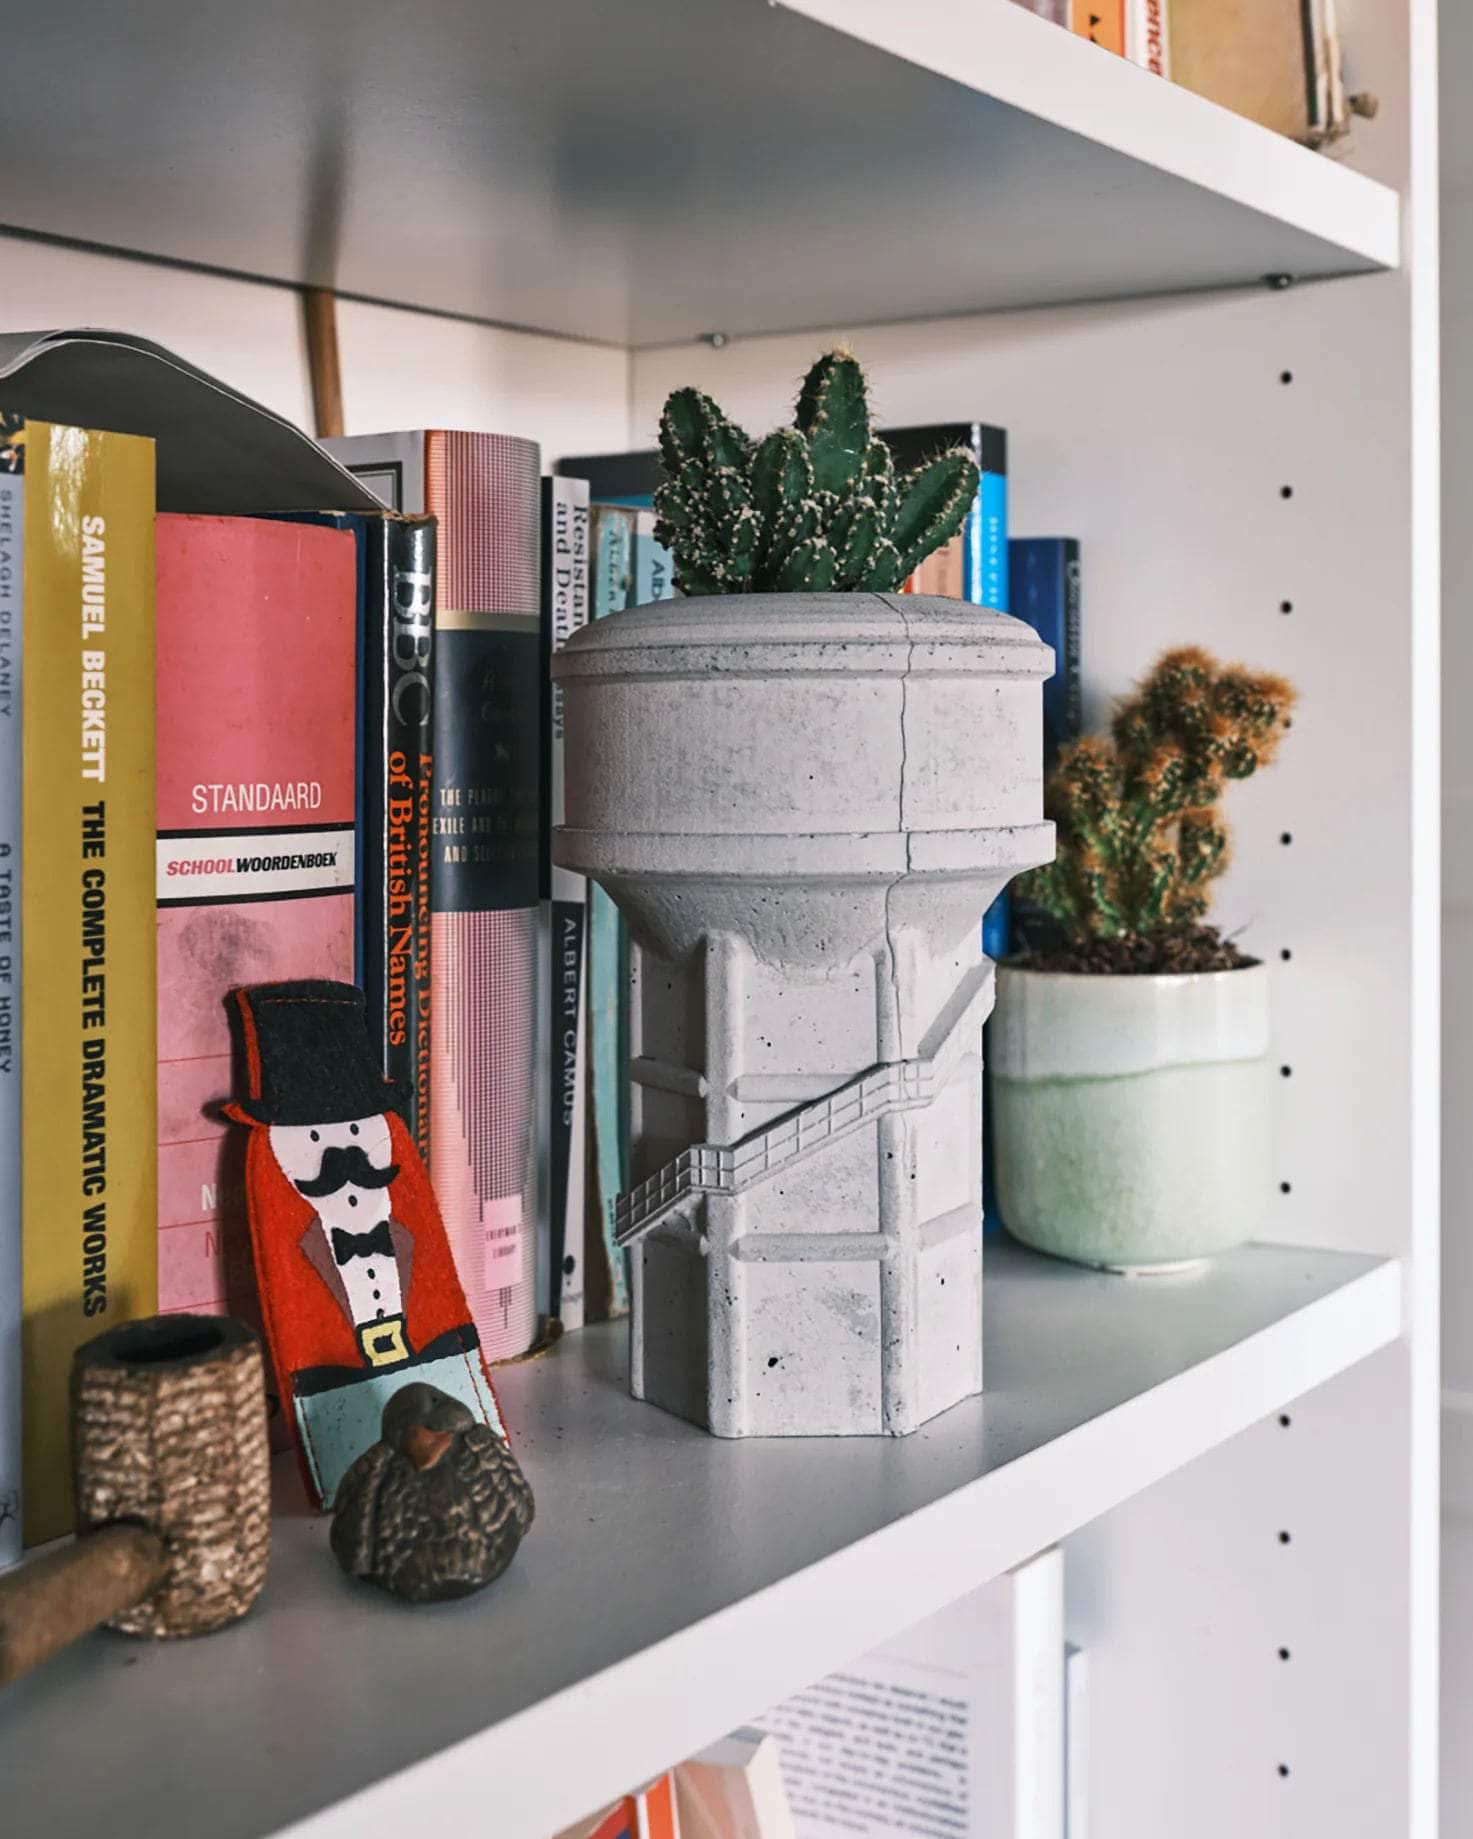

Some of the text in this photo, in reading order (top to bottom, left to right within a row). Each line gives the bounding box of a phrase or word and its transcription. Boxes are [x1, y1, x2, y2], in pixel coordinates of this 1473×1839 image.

[556, 502, 571, 554] and
[573, 504, 589, 626] Resistan
[0, 489, 13, 718] SHELAGH DELANEY
[81, 514, 106, 783] SAMUEL BECKETT
[392, 565, 432, 726] BBC
[191, 781, 322, 813] STANDAARD
[432, 817, 465, 834] EXILE
[440, 788, 461, 806] THE
[166, 851, 339, 877] SCHOOLWOORDENBOEK
[443, 845, 468, 863] AND
[0, 869, 13, 943] TASTE
[389, 751, 413, 1046] of British Names
[0, 956, 13, 984] OF
[563, 917, 577, 1019] ALBERT
[0, 996, 13, 1074] HONEY
[81, 801, 107, 1318] THE COMPLETE DRAMATIC WORKS
